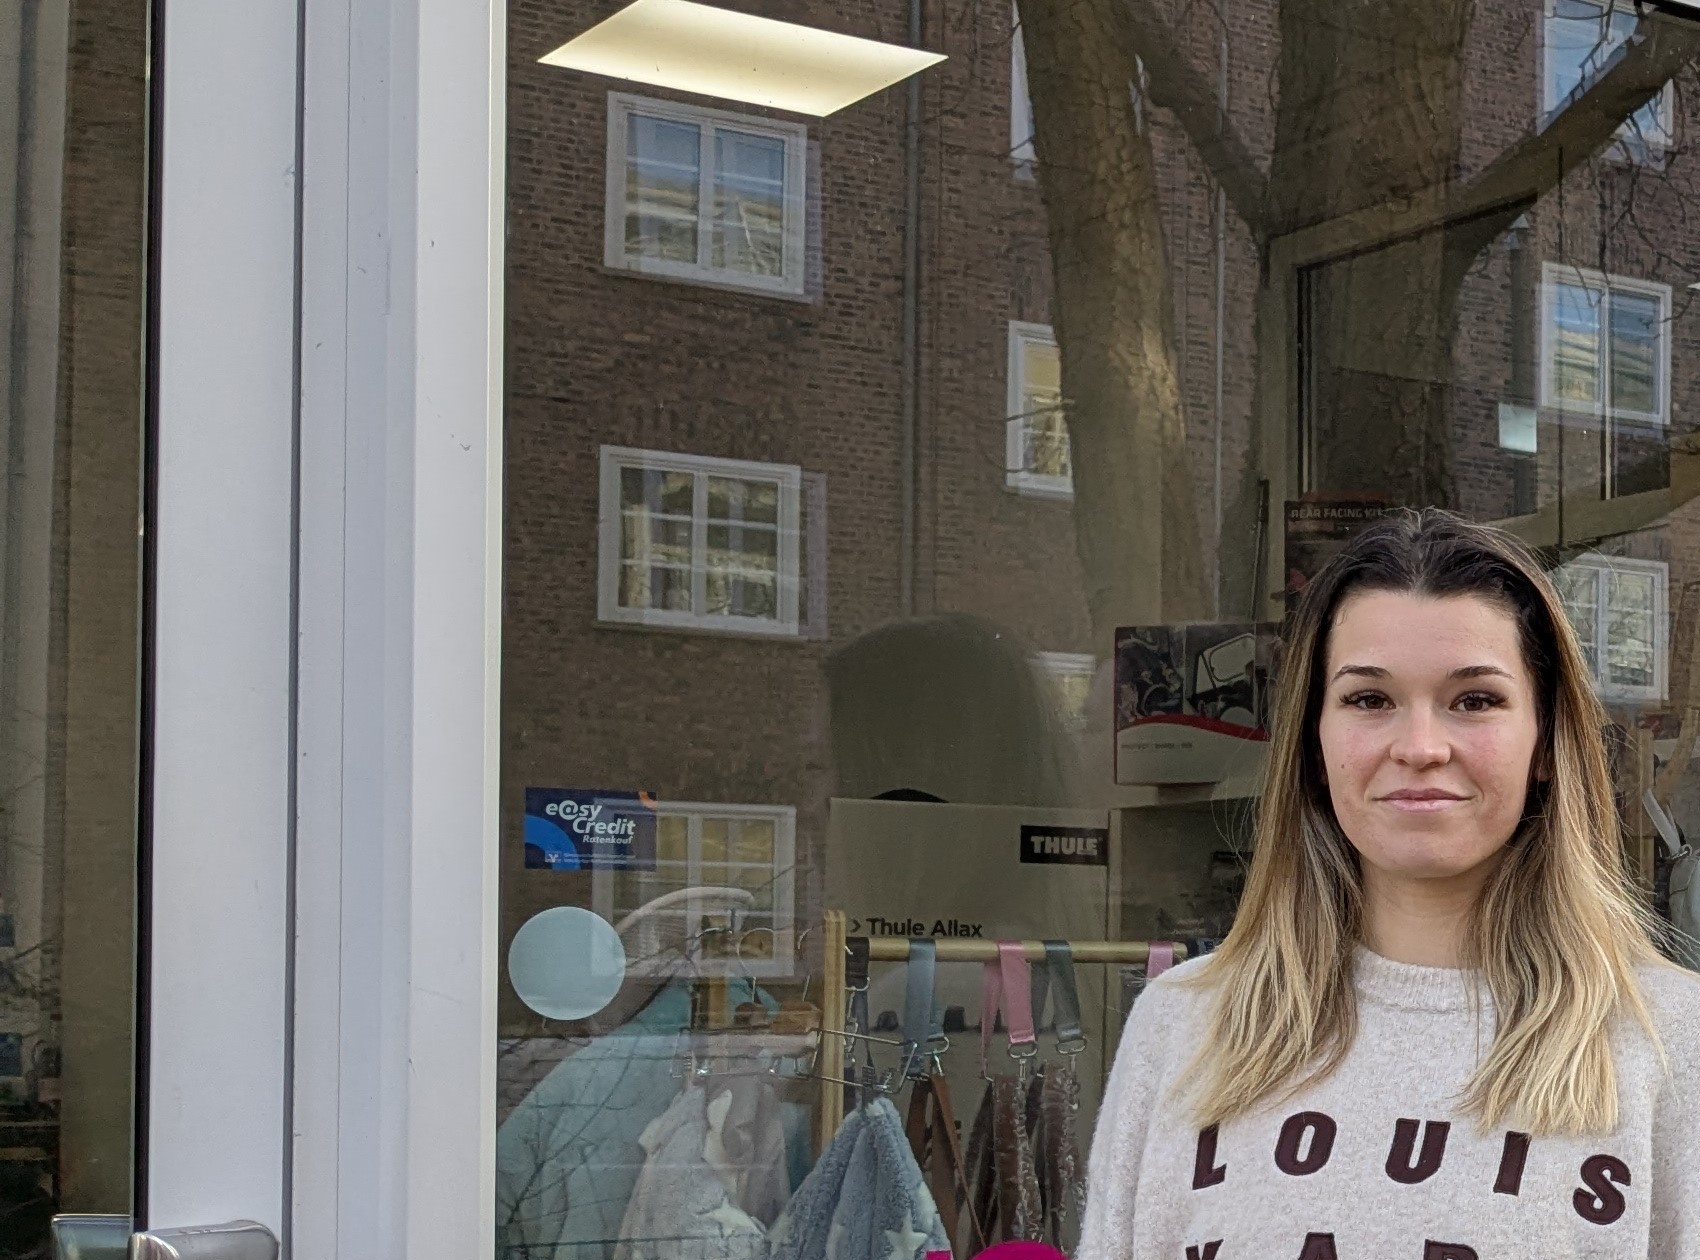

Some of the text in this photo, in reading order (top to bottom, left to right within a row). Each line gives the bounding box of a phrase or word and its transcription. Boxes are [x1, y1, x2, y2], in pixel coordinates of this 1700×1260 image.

[572, 817, 636, 835] Credit
[1031, 836, 1098, 856] THULE
[867, 918, 983, 938] Thule Allax
[1192, 1111, 1631, 1224] LOUIS
